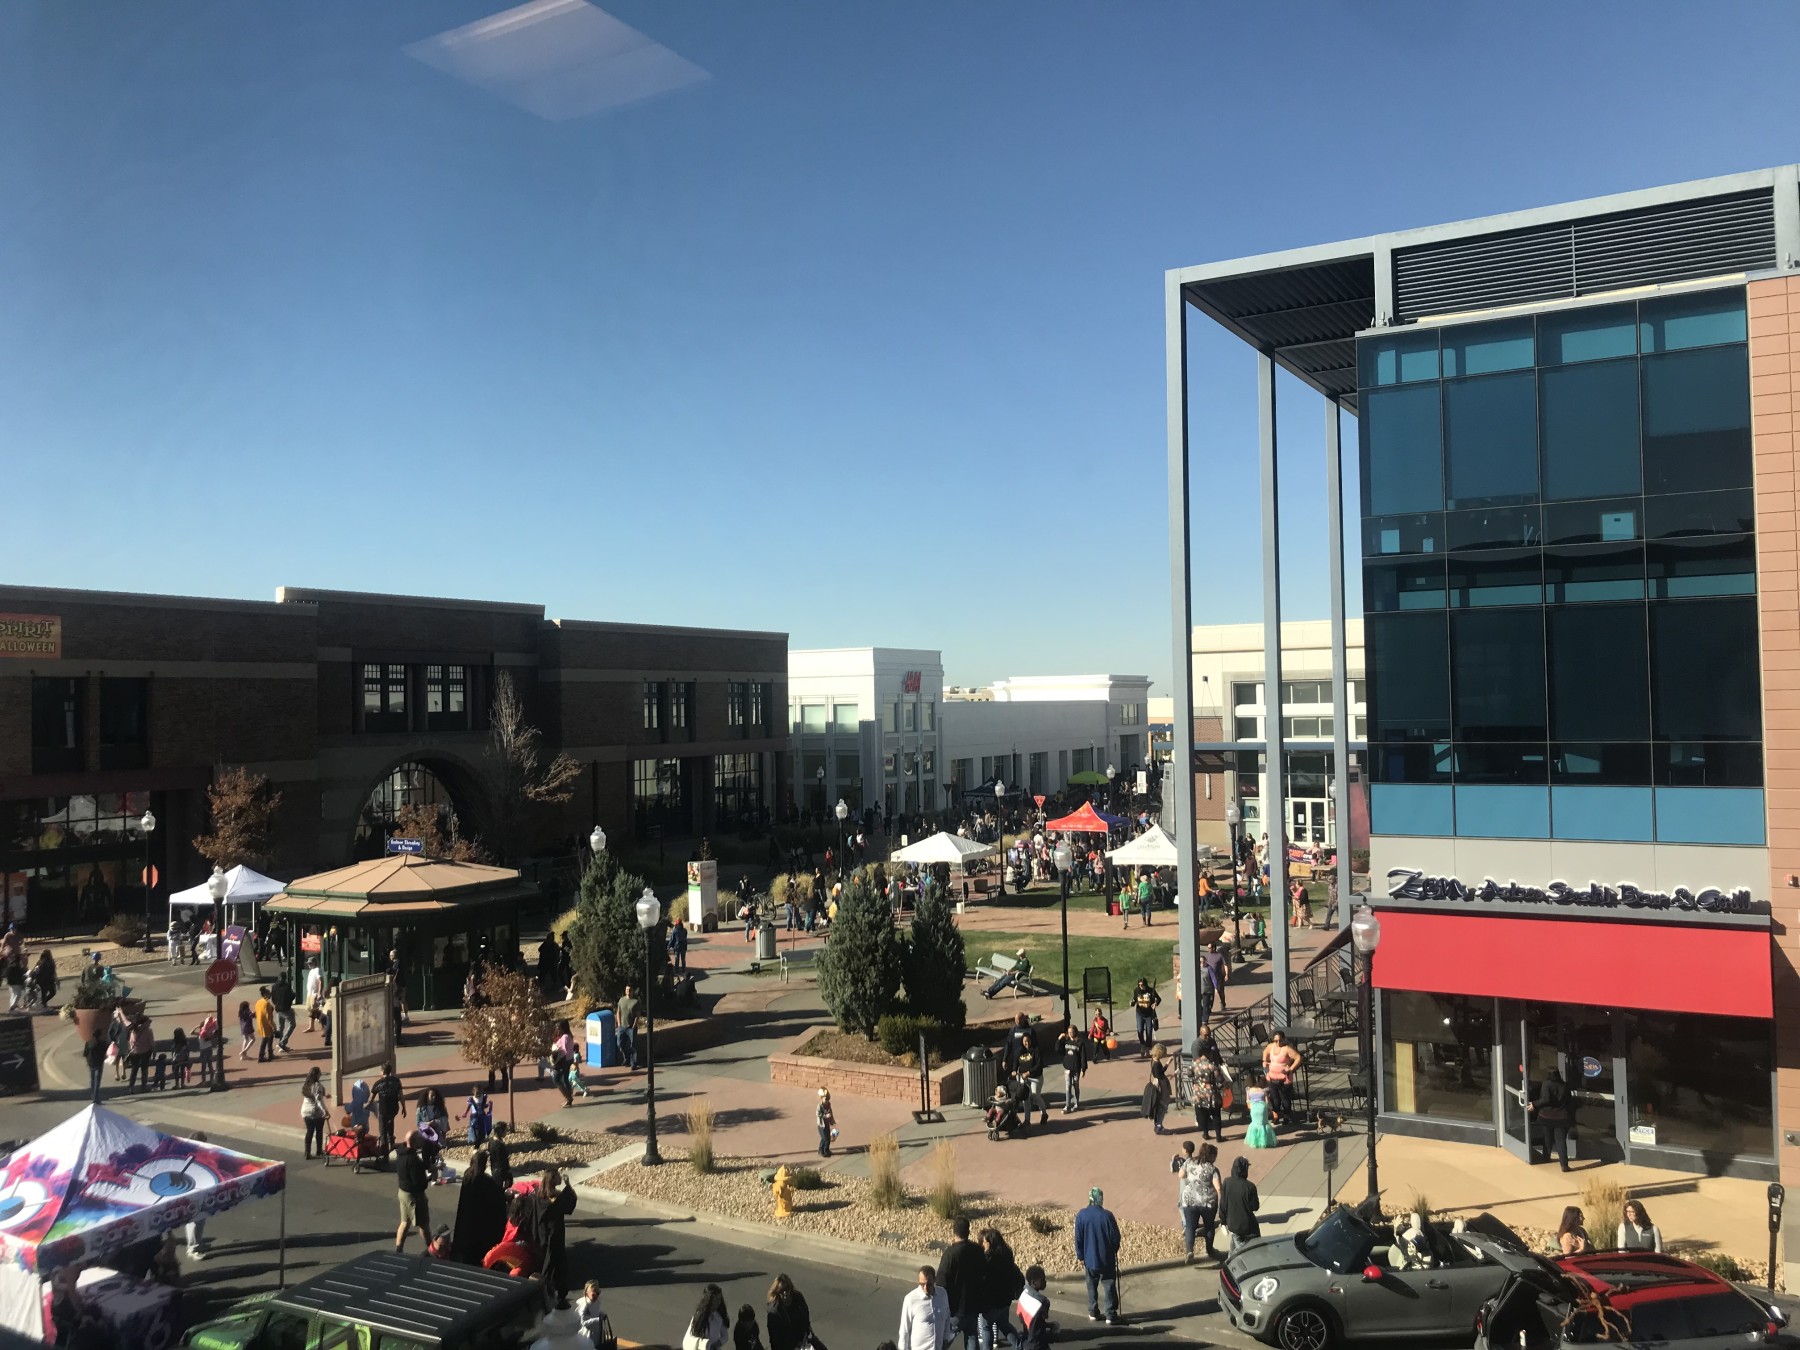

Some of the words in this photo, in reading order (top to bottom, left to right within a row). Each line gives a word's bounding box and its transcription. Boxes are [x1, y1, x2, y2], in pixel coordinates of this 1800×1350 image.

[1616, 880, 1668, 908] Bar
[1670, 884, 1697, 911] &
[1695, 885, 1752, 912] Grill
[207, 970, 236, 984] STOP
[150, 1200, 200, 1226] bang
[205, 1183, 250, 1207] bang
